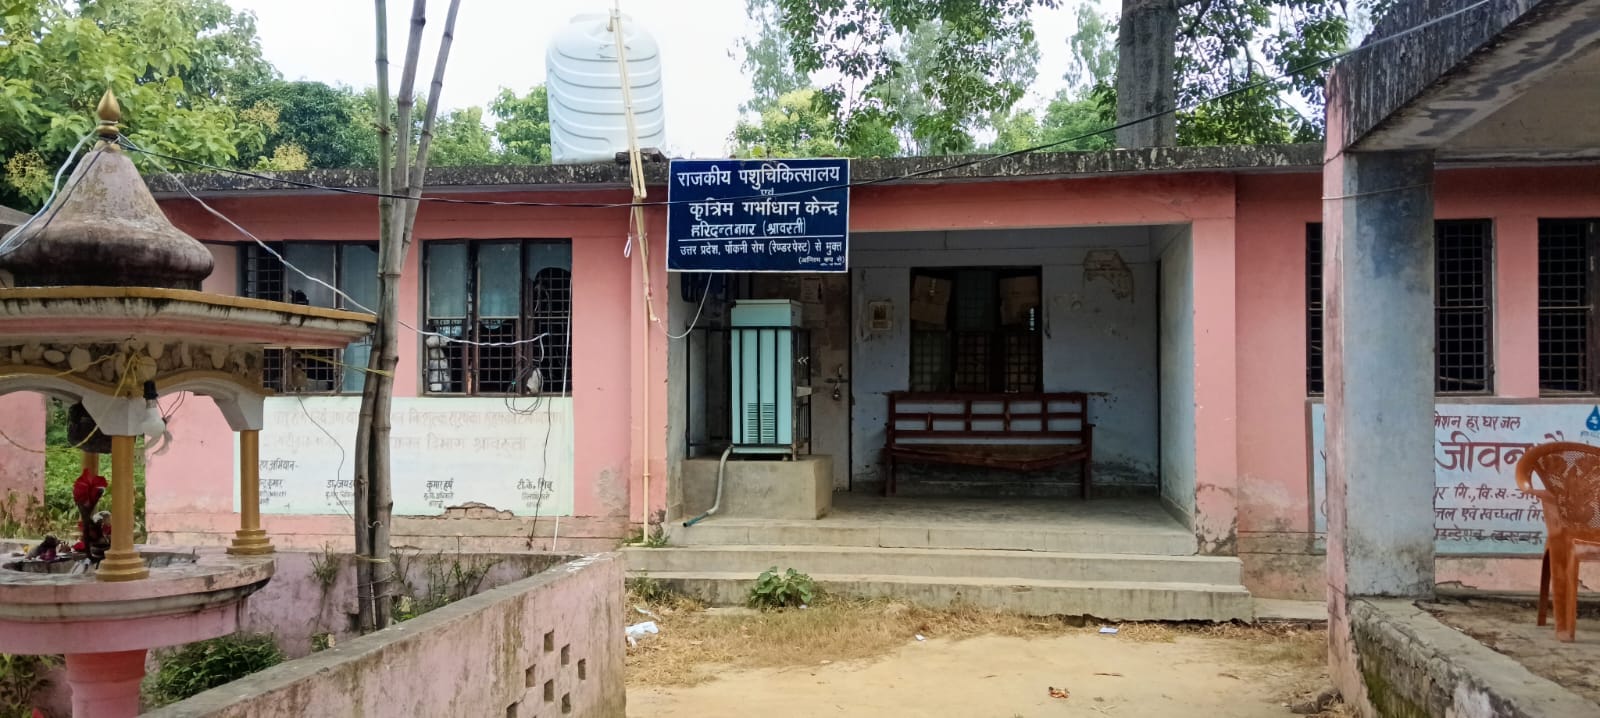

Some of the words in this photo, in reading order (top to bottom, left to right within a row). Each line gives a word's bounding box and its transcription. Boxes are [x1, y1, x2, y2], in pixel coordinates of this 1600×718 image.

[677, 165, 731, 187] राजकीय
[738, 162, 841, 190] पशुचिकित्सालय
[689, 197, 734, 221] कृत्रिम
[741, 196, 801, 216] गर्भाधान
[804, 195, 840, 216] केन्द्र
[680, 244, 697, 256] उत्तर
[751, 239, 765, 254] रोग
[814, 238, 822, 252] से
[826, 239, 843, 256] मुक्त
[1465, 415, 1480, 432] हर
[1482, 415, 1499, 431] घर
[1500, 415, 1521, 431] जल
[1434, 507, 1458, 521] जल
[1461, 504, 1479, 521] एवं
